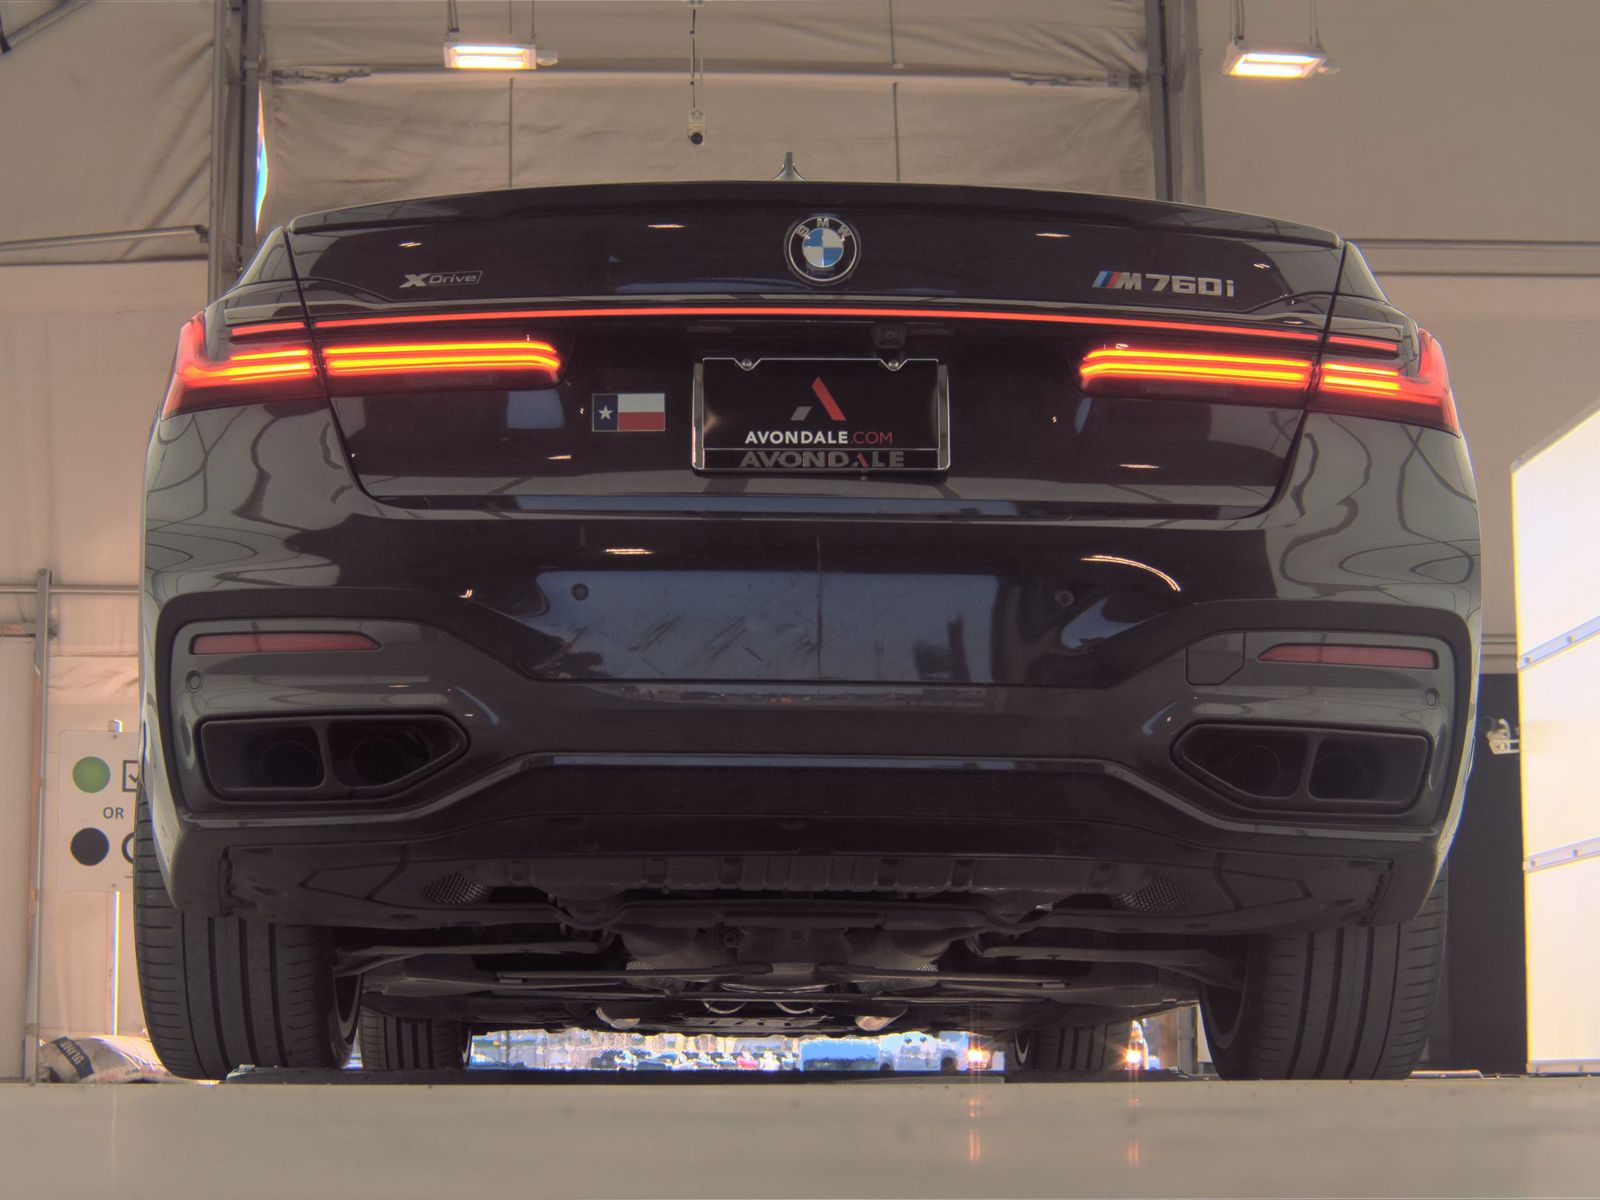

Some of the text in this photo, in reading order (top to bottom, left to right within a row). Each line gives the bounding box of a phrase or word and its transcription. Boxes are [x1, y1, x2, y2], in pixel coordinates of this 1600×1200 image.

[796, 216, 851, 240] BMW
[744, 431, 894, 445] AVONDALE.COM
[739, 451, 905, 468] AVONDALE
[103, 806, 124, 819] OR
